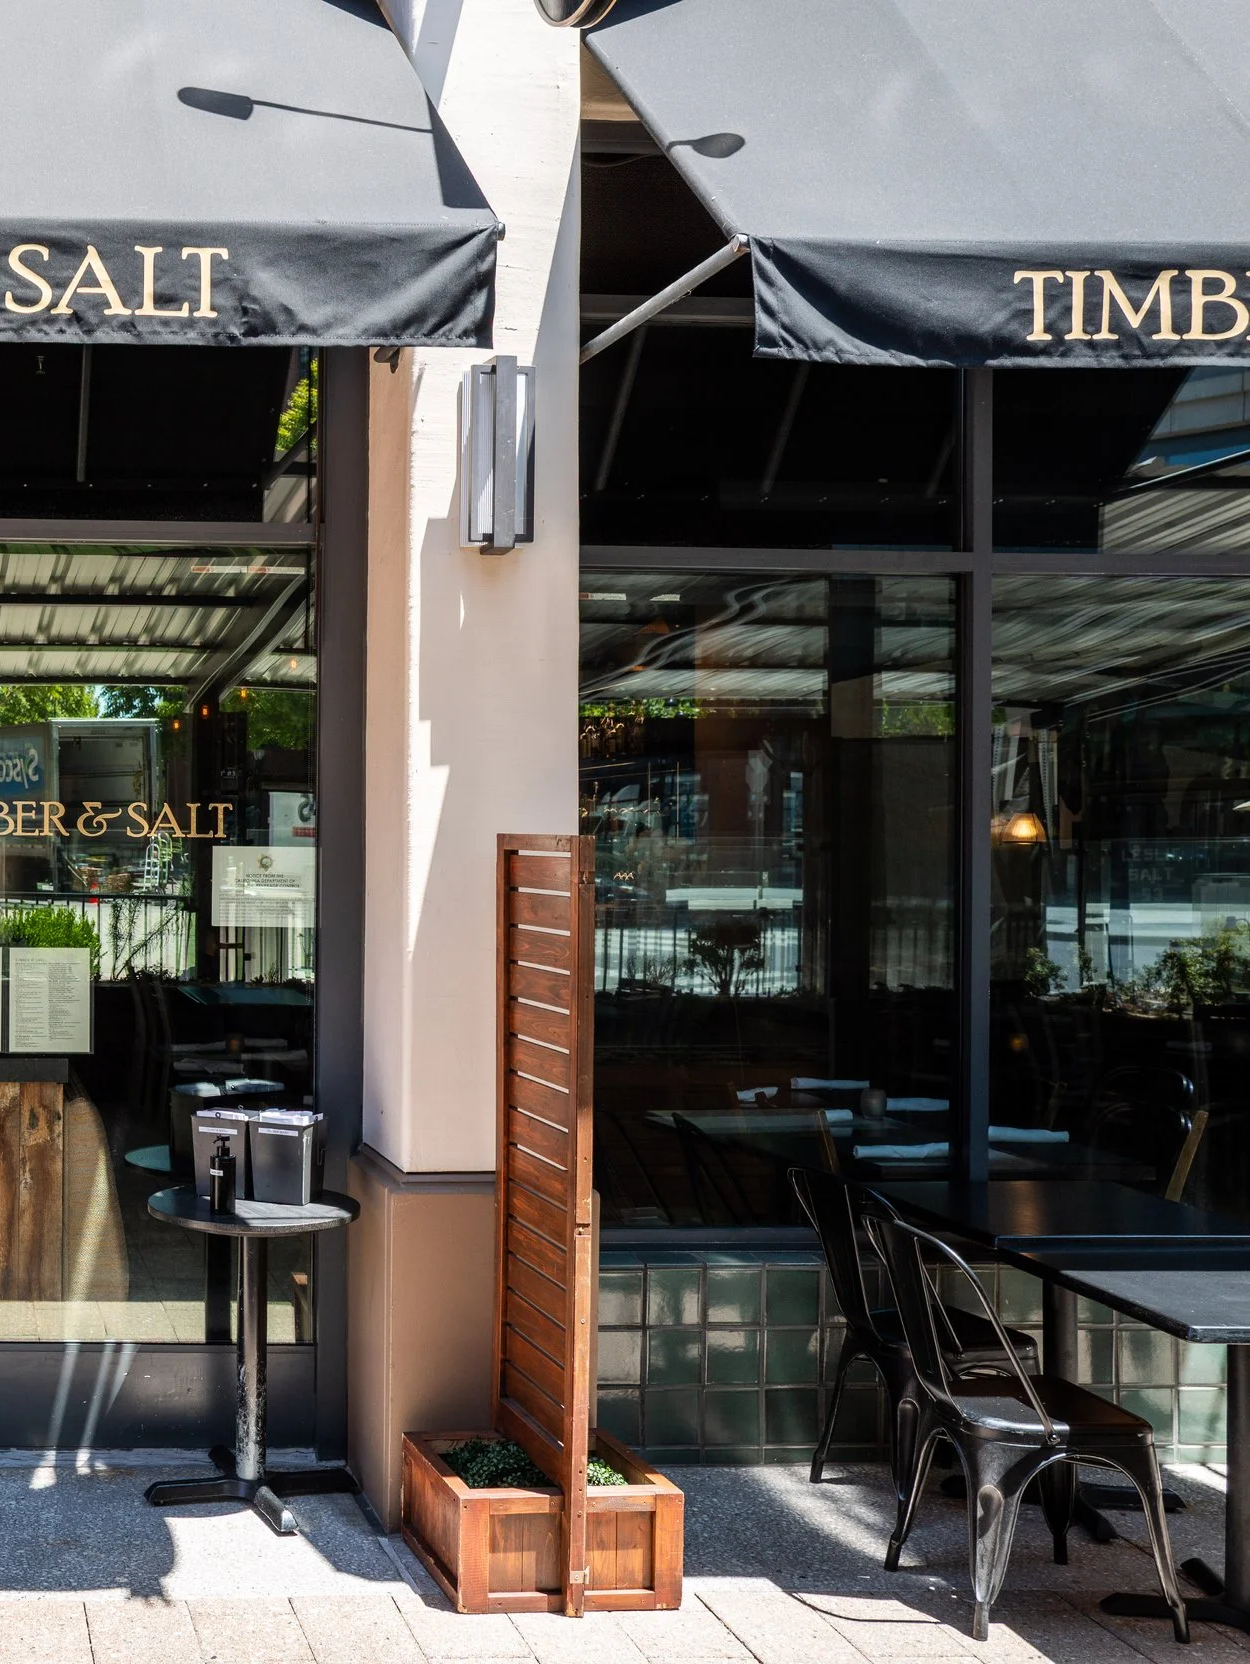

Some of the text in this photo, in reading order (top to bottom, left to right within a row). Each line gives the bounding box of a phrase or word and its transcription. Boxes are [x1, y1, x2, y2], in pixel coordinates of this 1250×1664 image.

[5, 244, 229, 319] SALT
[1013, 268, 1250, 342] TIMB
[76, 801, 122, 838] &
[126, 802, 234, 839] SALT
